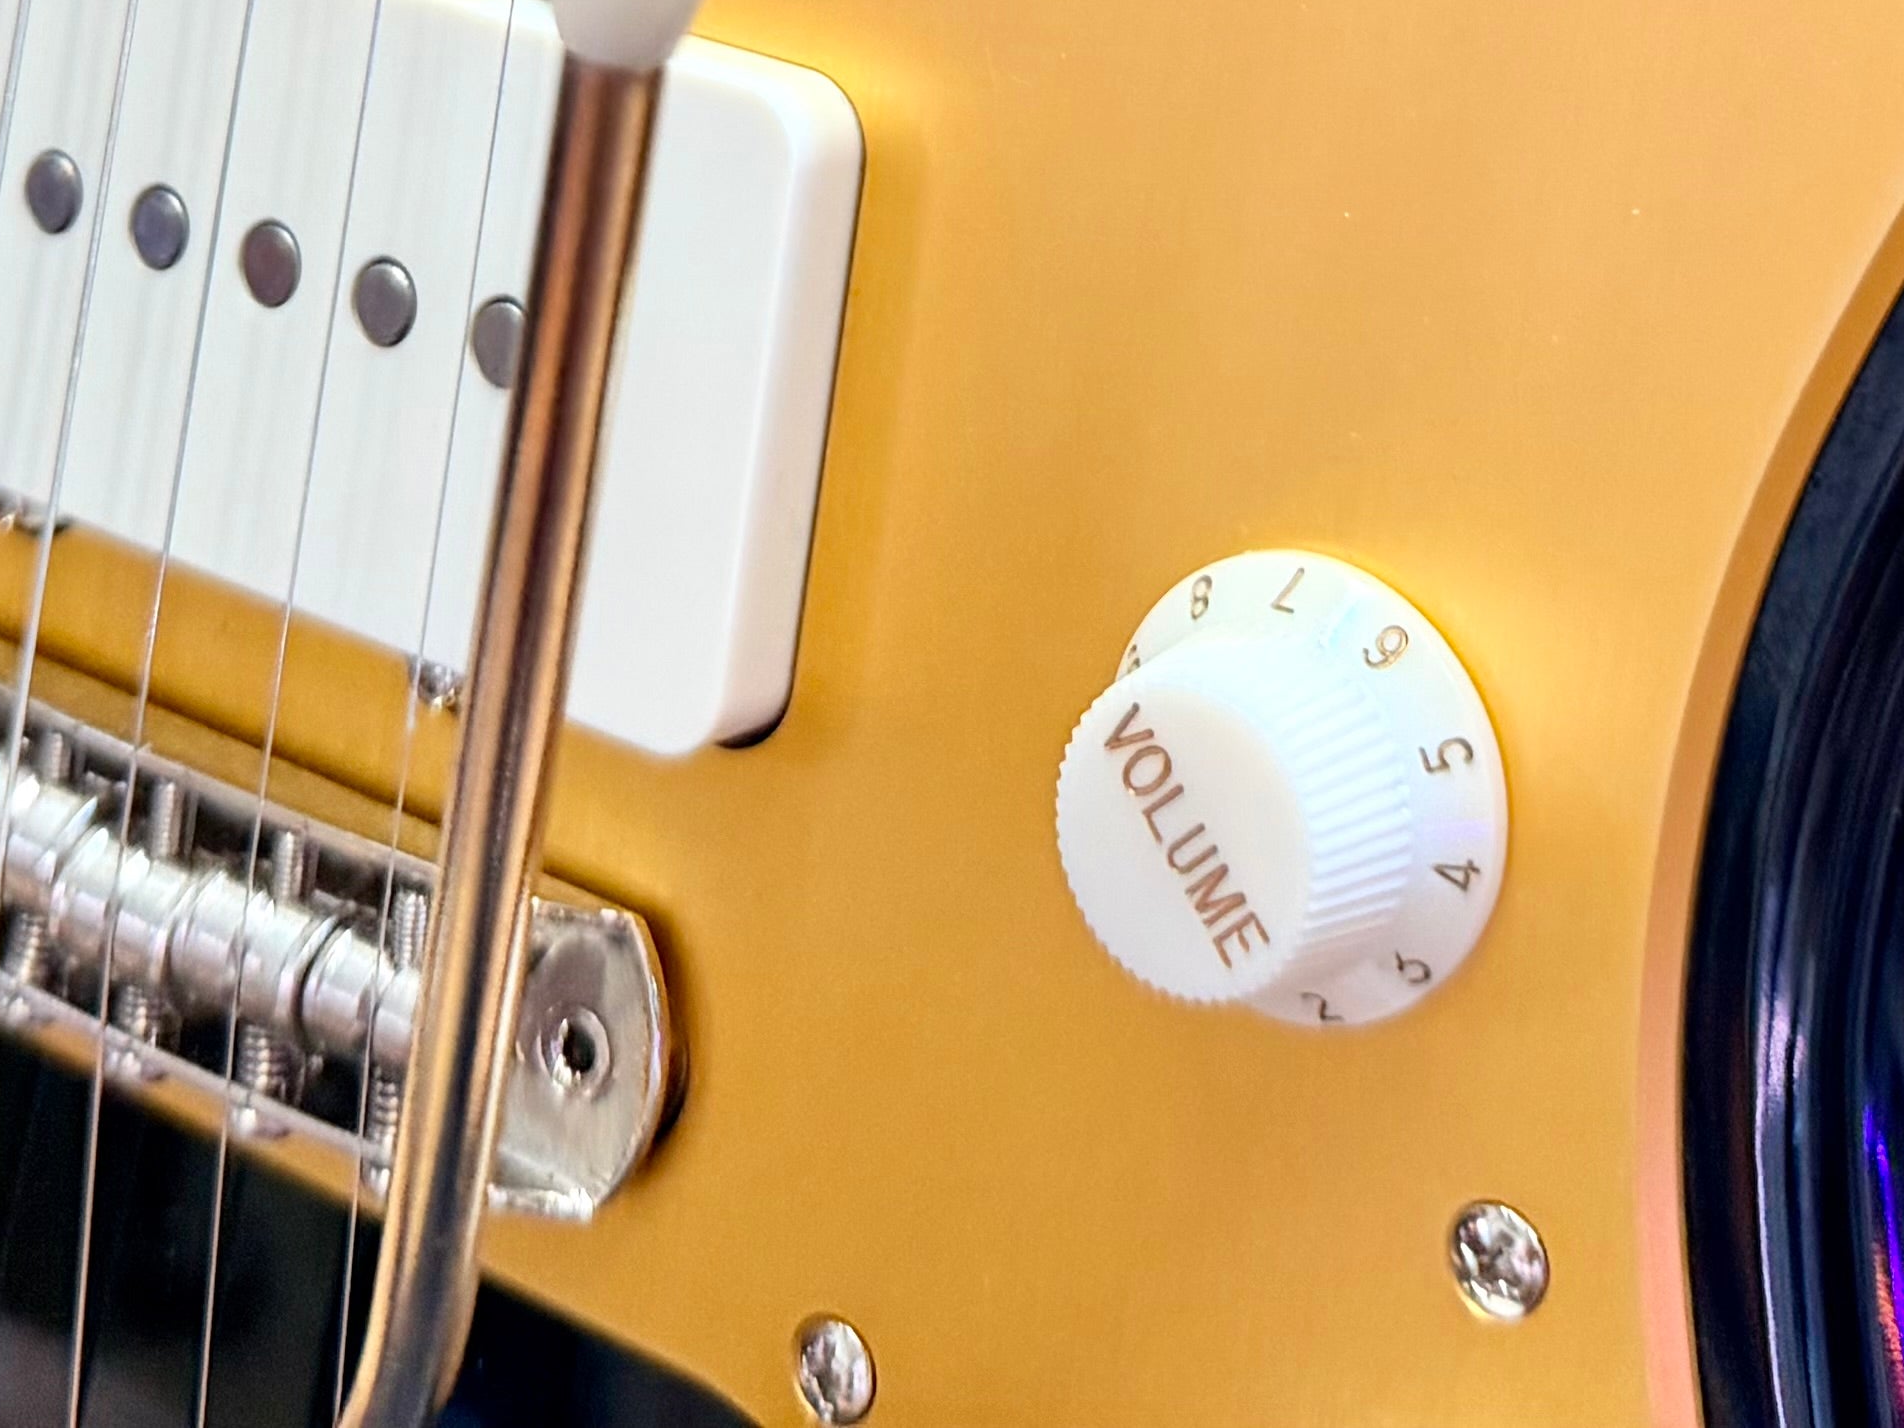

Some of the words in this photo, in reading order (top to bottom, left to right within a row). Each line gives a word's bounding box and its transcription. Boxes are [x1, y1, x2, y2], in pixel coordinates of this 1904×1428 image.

[1190, 575, 1213, 620] 8
[1271, 567, 1305, 614] 7
[1419, 737, 1474, 775] 5
[1102, 702, 1271, 969] VOLUME
[1434, 859, 1481, 892] 4
